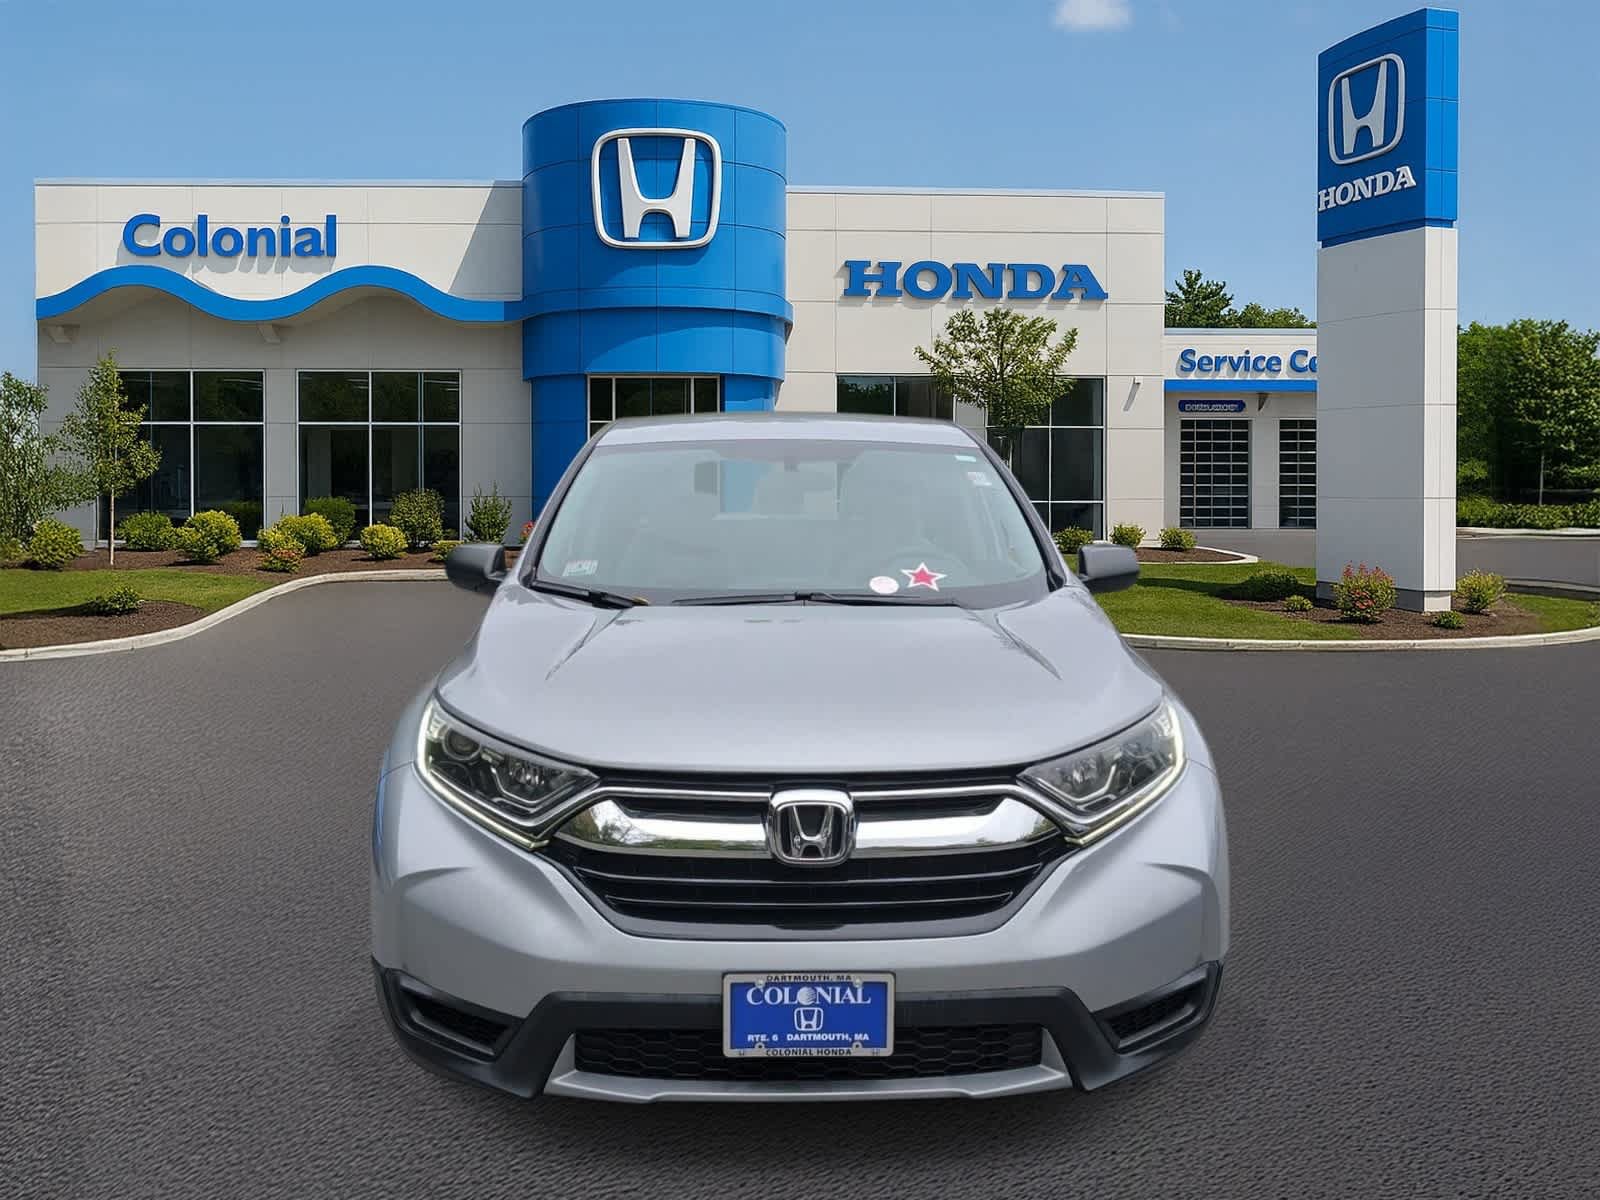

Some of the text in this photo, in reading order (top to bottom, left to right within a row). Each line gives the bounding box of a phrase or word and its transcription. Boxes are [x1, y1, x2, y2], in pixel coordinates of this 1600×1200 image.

[1318, 165, 1416, 212] HONDA
[122, 213, 337, 258] Colonial
[843, 260, 1109, 300] HONDA
[1180, 348, 1282, 373] Service
[836, 974, 852, 982] MA
[746, 986, 872, 1006] COLONIAL
[748, 1034, 769, 1042] RTE.
[772, 1034, 779, 1042] 6
[786, 1033, 852, 1042] DARTMOUTH,
[766, 1048, 852, 1057] COLONIAL HONDA
